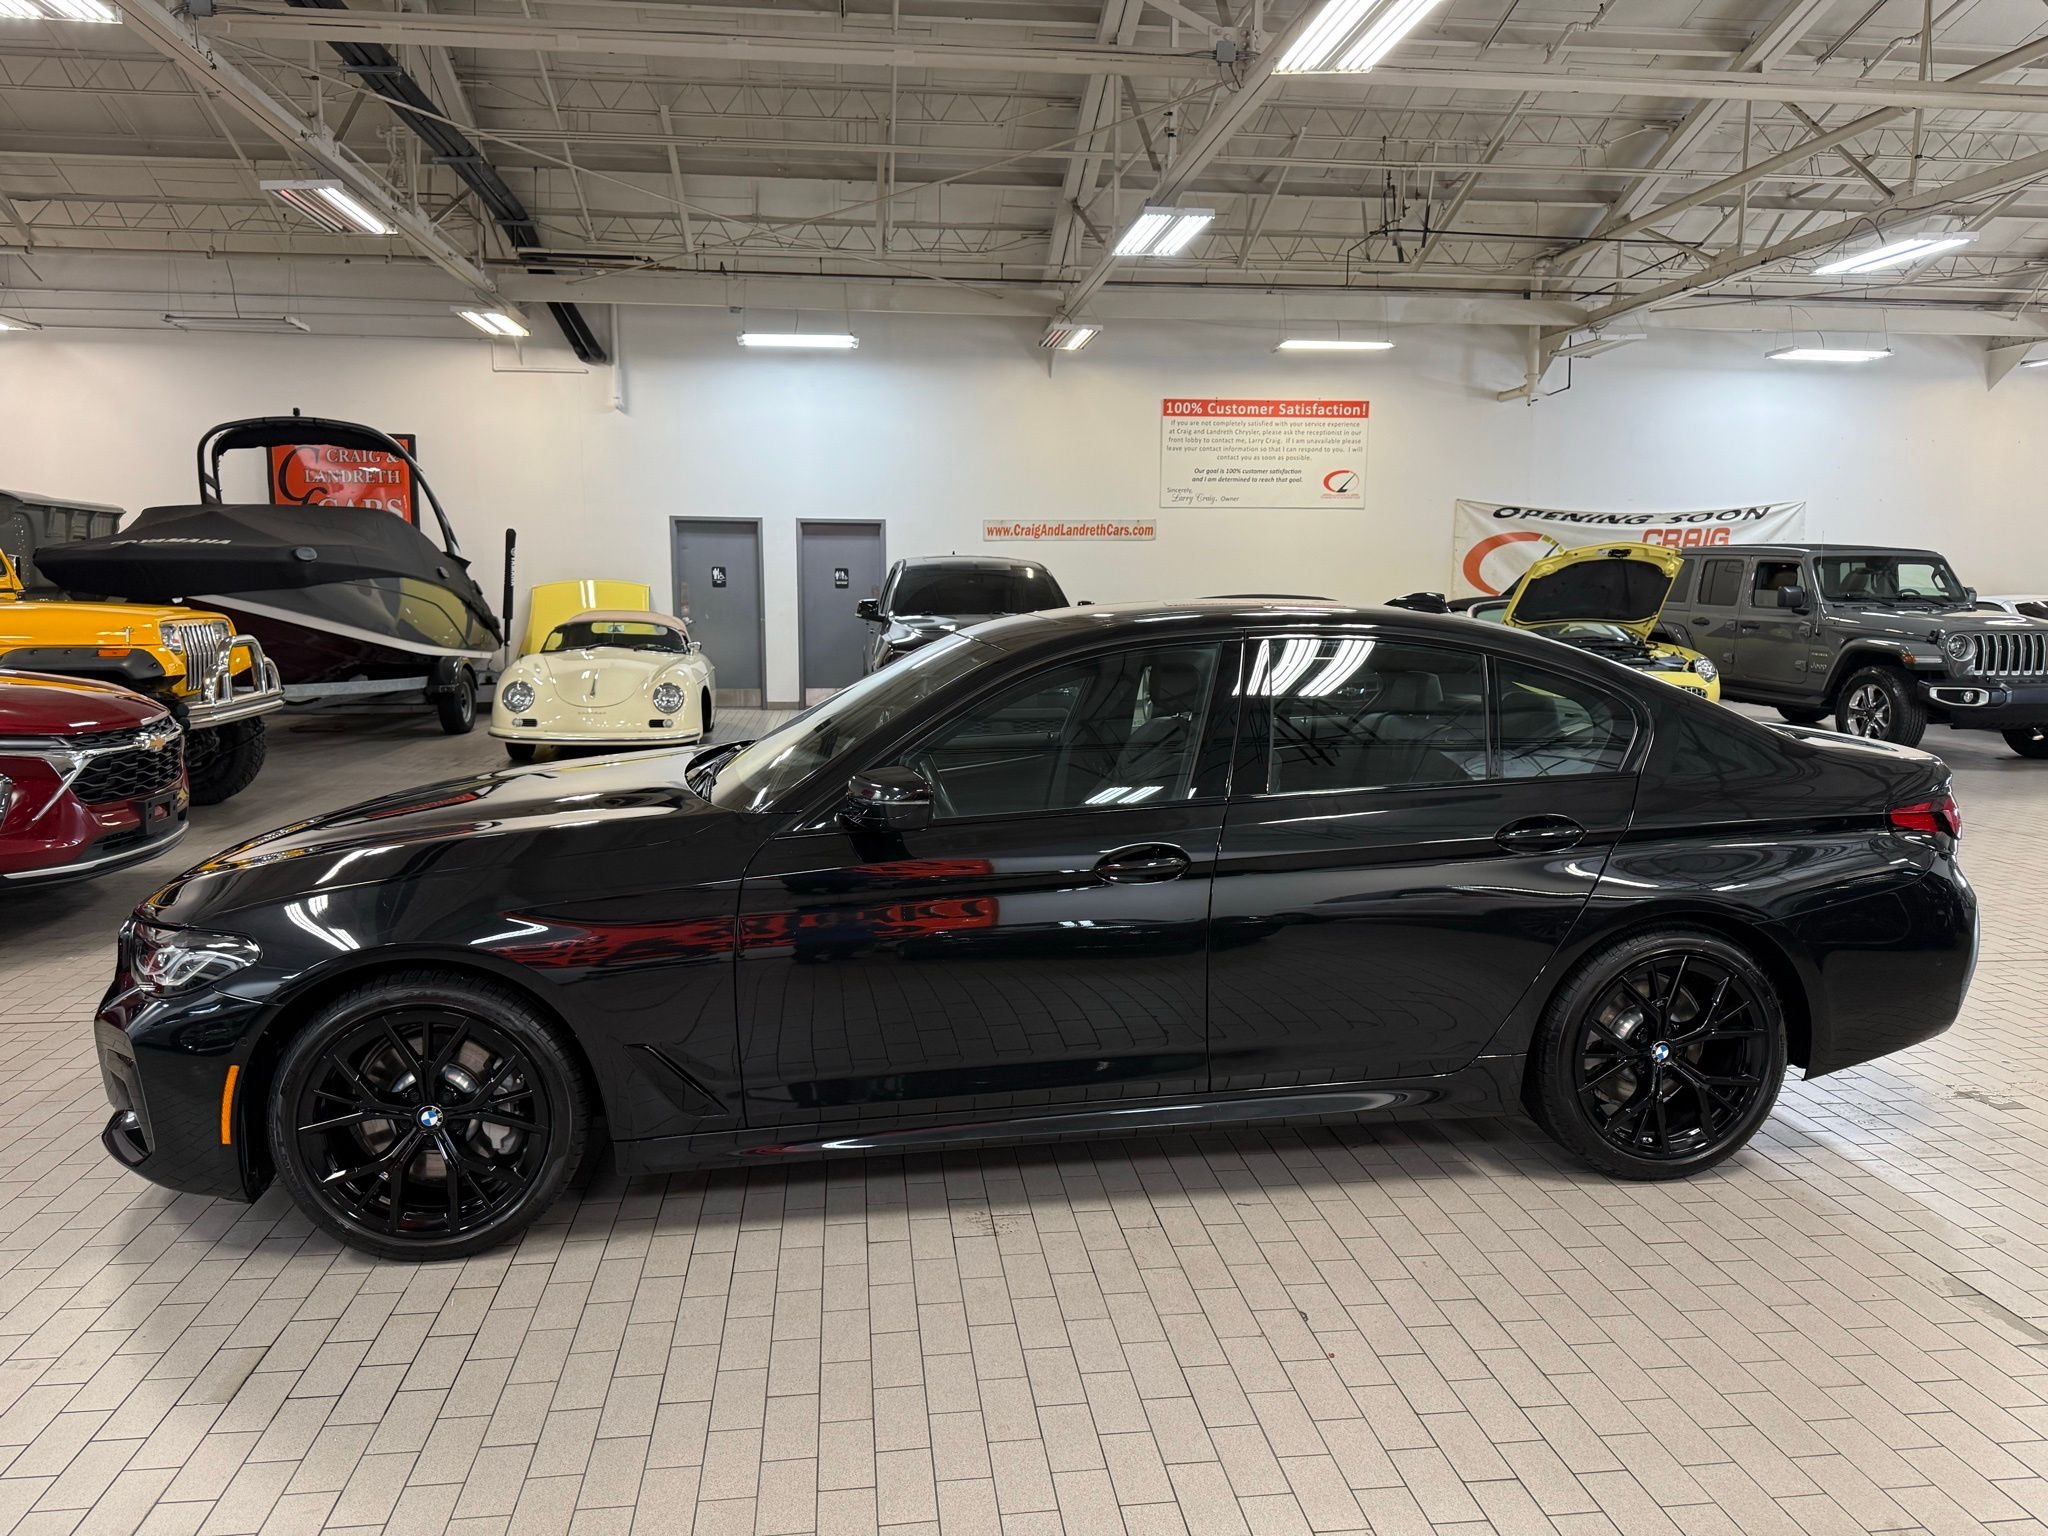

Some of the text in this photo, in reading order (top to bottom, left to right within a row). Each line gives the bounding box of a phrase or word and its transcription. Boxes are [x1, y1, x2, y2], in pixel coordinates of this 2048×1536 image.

[1166, 402, 1367, 416] 100% Customer Satisfaction!
[1235, 429, 1260, 437] Chrysler,
[326, 449, 400, 463] CRAIG &
[304, 470, 401, 483] LANDRETH
[1492, 506, 1771, 525] OPENING SOON
[986, 523, 1154, 538] www.CraigAndLandrethCars.com
[1642, 527, 1732, 546] CRAIG
